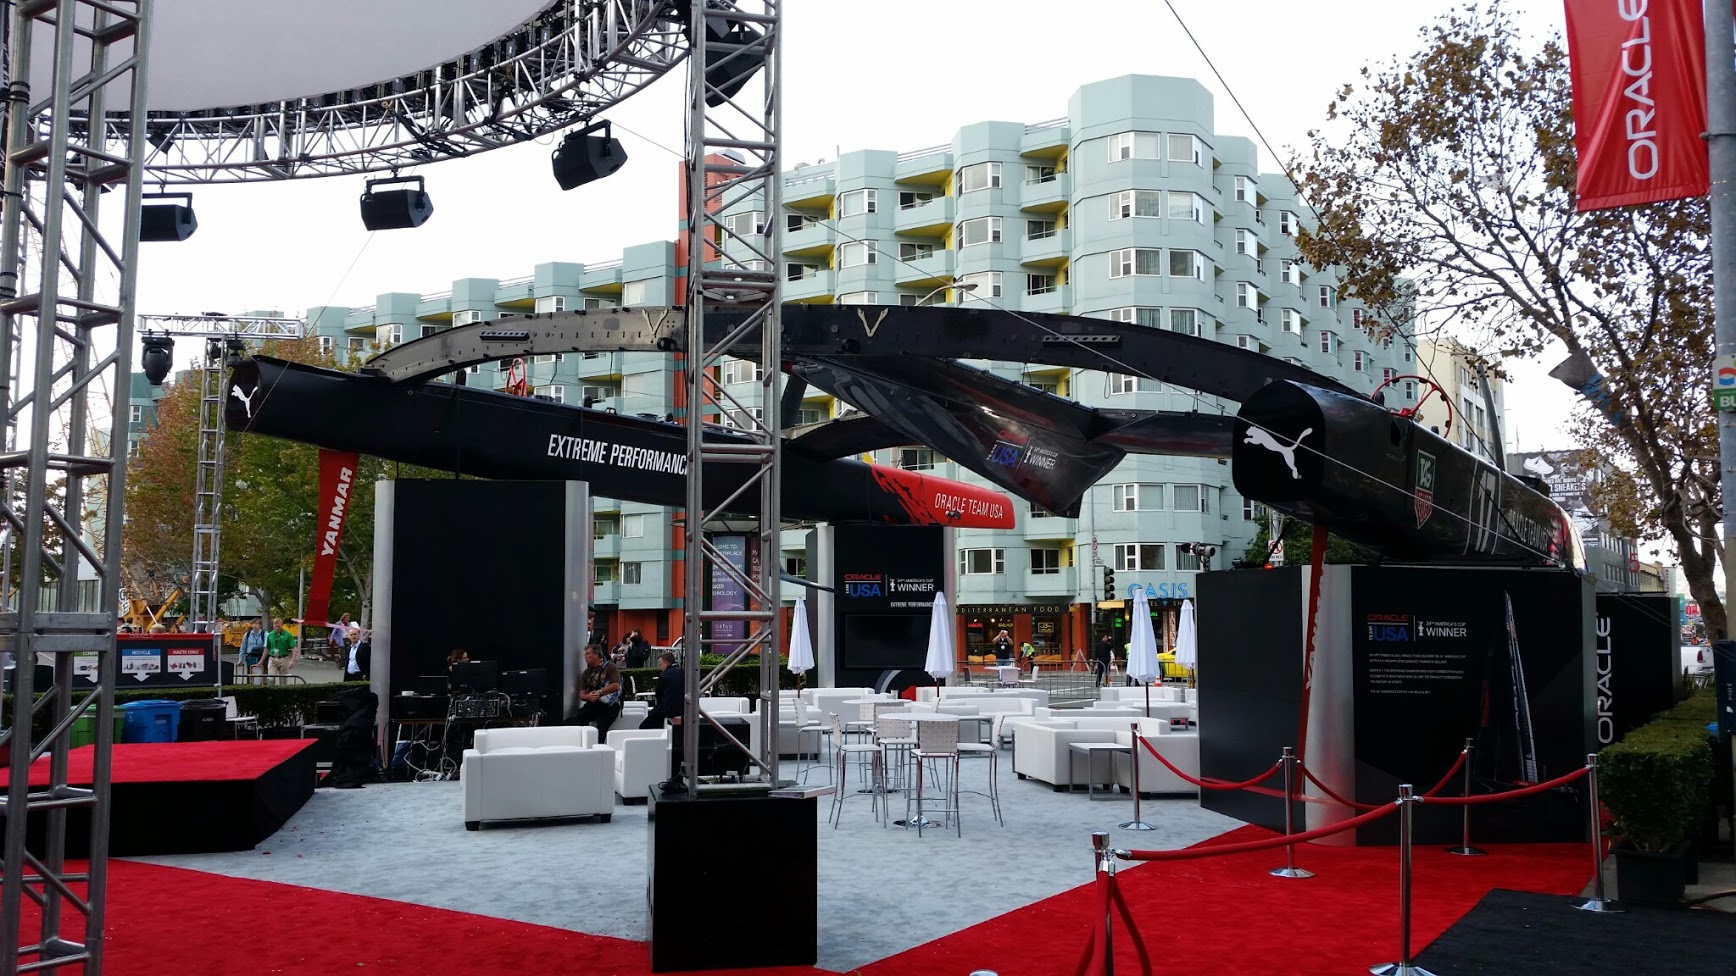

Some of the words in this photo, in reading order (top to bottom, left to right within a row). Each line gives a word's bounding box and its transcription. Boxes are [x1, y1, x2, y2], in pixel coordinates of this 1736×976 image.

[1618, 0, 1659, 180] ORACLE
[547, 433, 608, 464] EXTREME
[609, 443, 687, 476] PERFORMANC
[991, 445, 1018, 467] USA
[1029, 453, 1056, 471] WINNER
[1554, 483, 1586, 492] SNEAKES
[321, 467, 353, 556] YANMAR
[934, 492, 967, 514] ORACLE
[968, 499, 989, 517] TEAM
[989, 503, 1003, 519] USA
[1477, 469, 1496, 553] 17
[850, 584, 881, 597] USA
[897, 583, 934, 592] WINNER
[1128, 582, 1188, 599] OASIS
[1367, 614, 1408, 622] ORACLE
[1374, 626, 1409, 642] USA
[1426, 627, 1467, 638] WINNER
[1596, 616, 1614, 744] ORACLE
